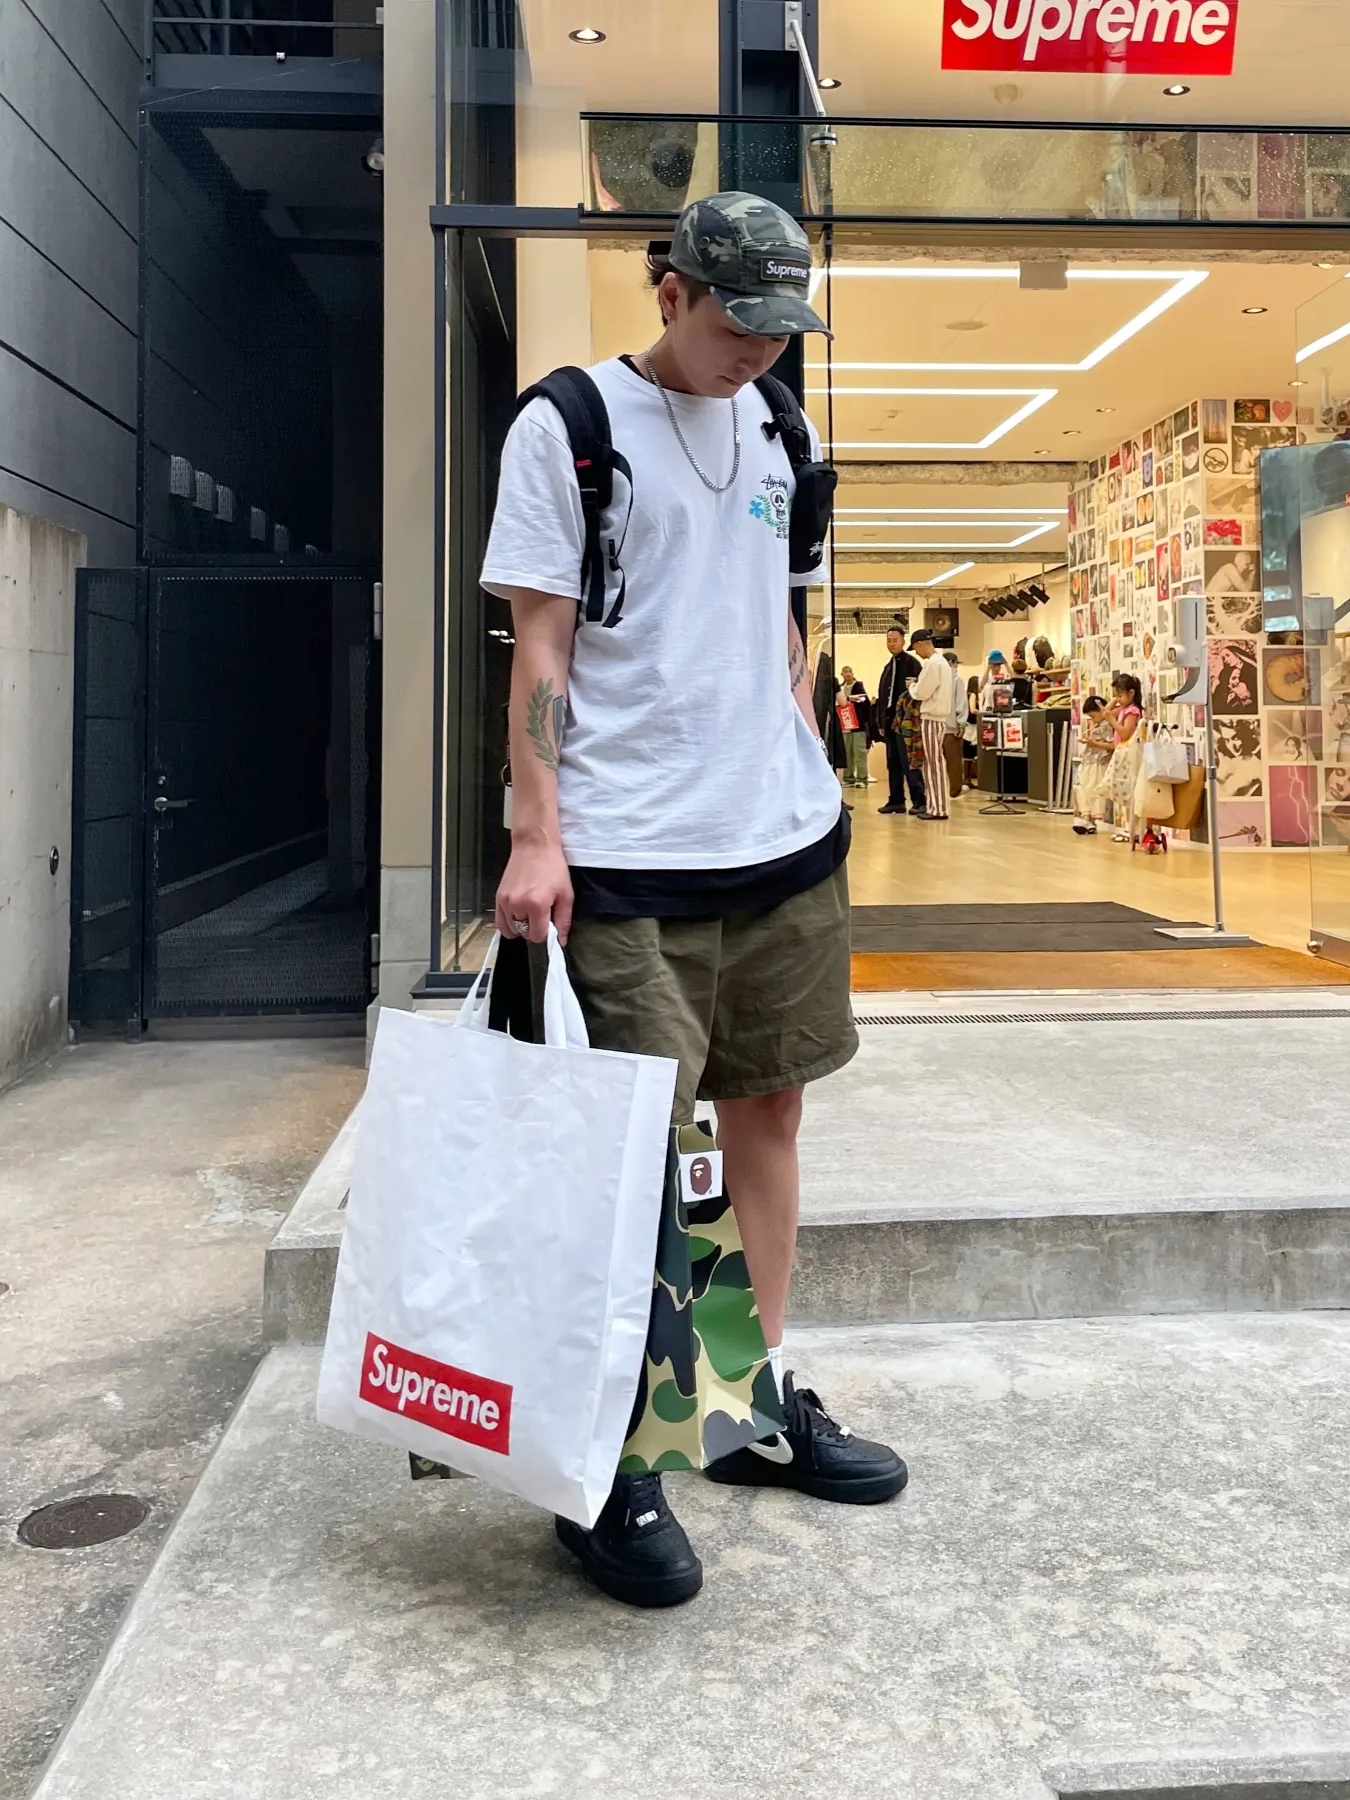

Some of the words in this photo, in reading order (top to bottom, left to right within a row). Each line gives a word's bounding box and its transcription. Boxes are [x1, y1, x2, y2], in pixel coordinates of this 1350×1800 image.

[951, 0, 1230, 61] Supreme
[766, 261, 808, 279] Supreme
[368, 1343, 500, 1431] Supreme
